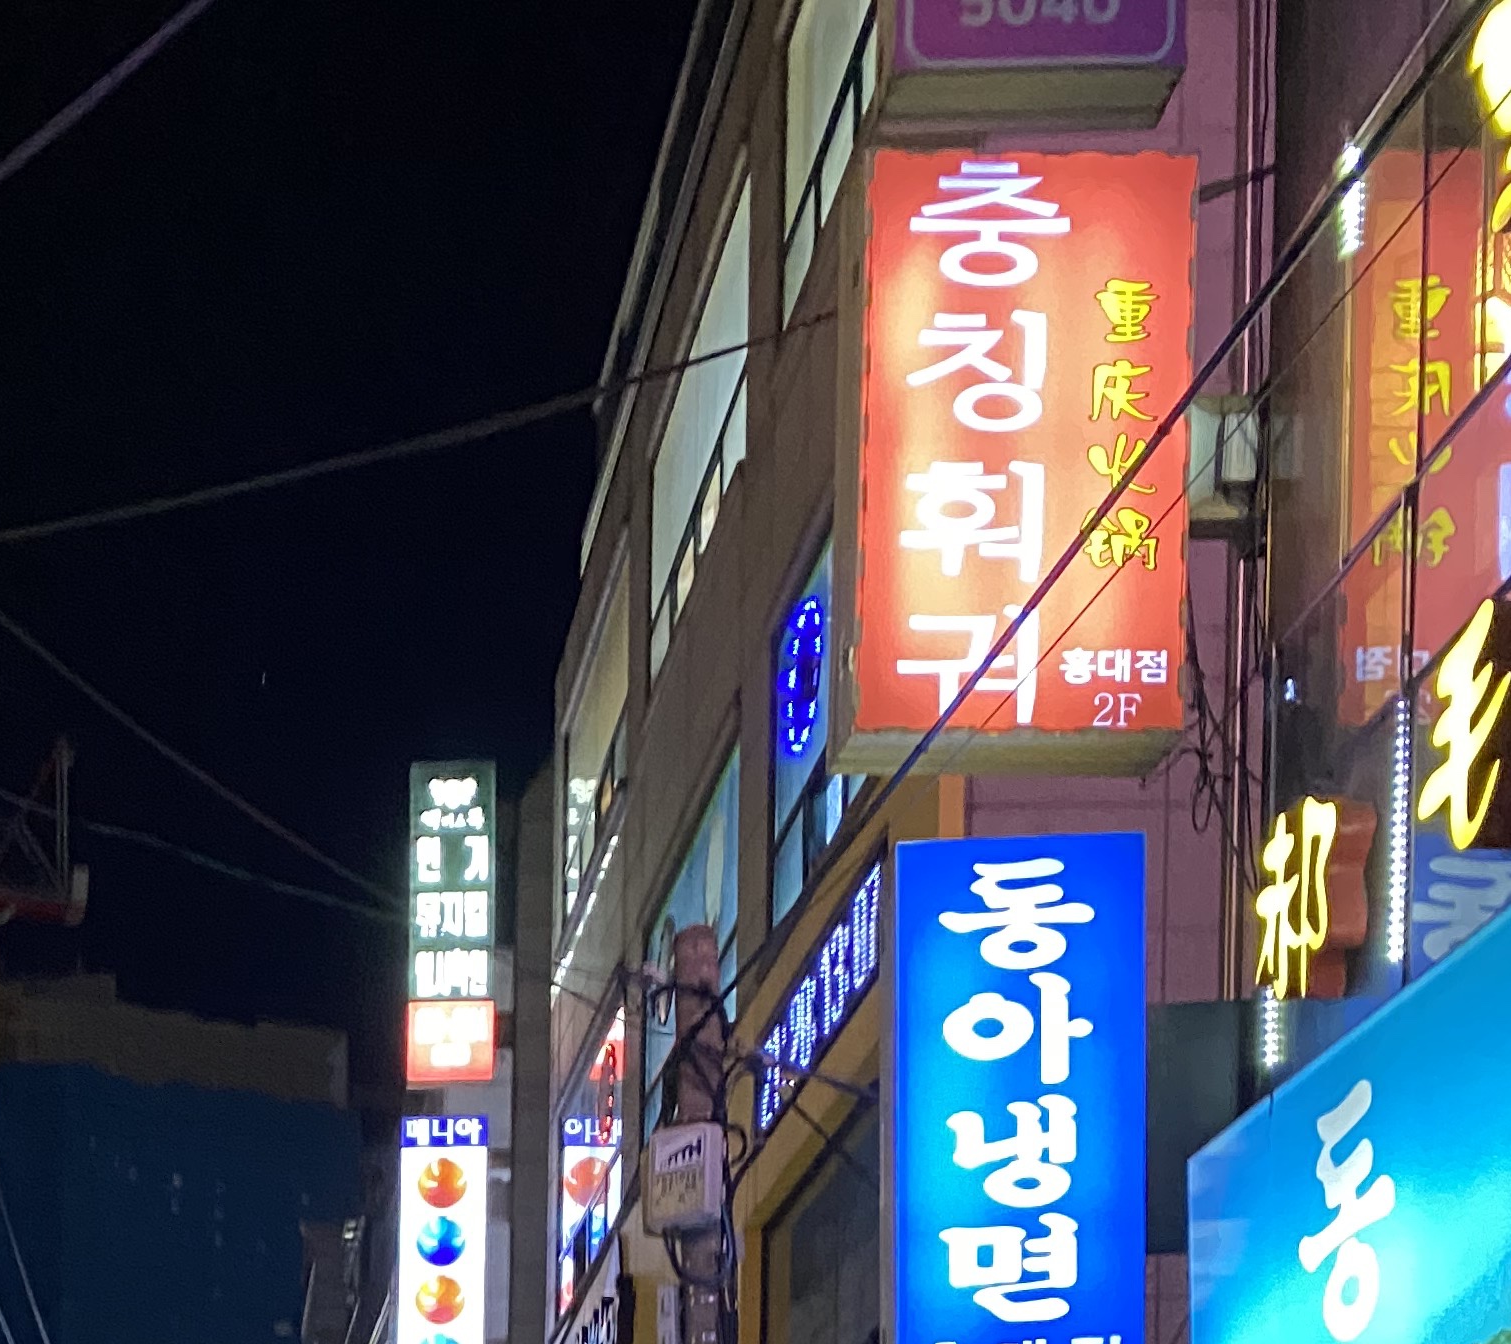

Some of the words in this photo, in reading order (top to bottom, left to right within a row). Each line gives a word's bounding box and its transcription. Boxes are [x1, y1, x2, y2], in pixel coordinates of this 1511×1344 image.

[896, 160, 1071, 726] 충칭훠궈
[1059, 649, 1169, 684] 홍대점
[1092, 692, 1143, 727] 2F
[938, 857, 1095, 1323] 동아냉면
[1297, 1078, 1396, 1342] 동
